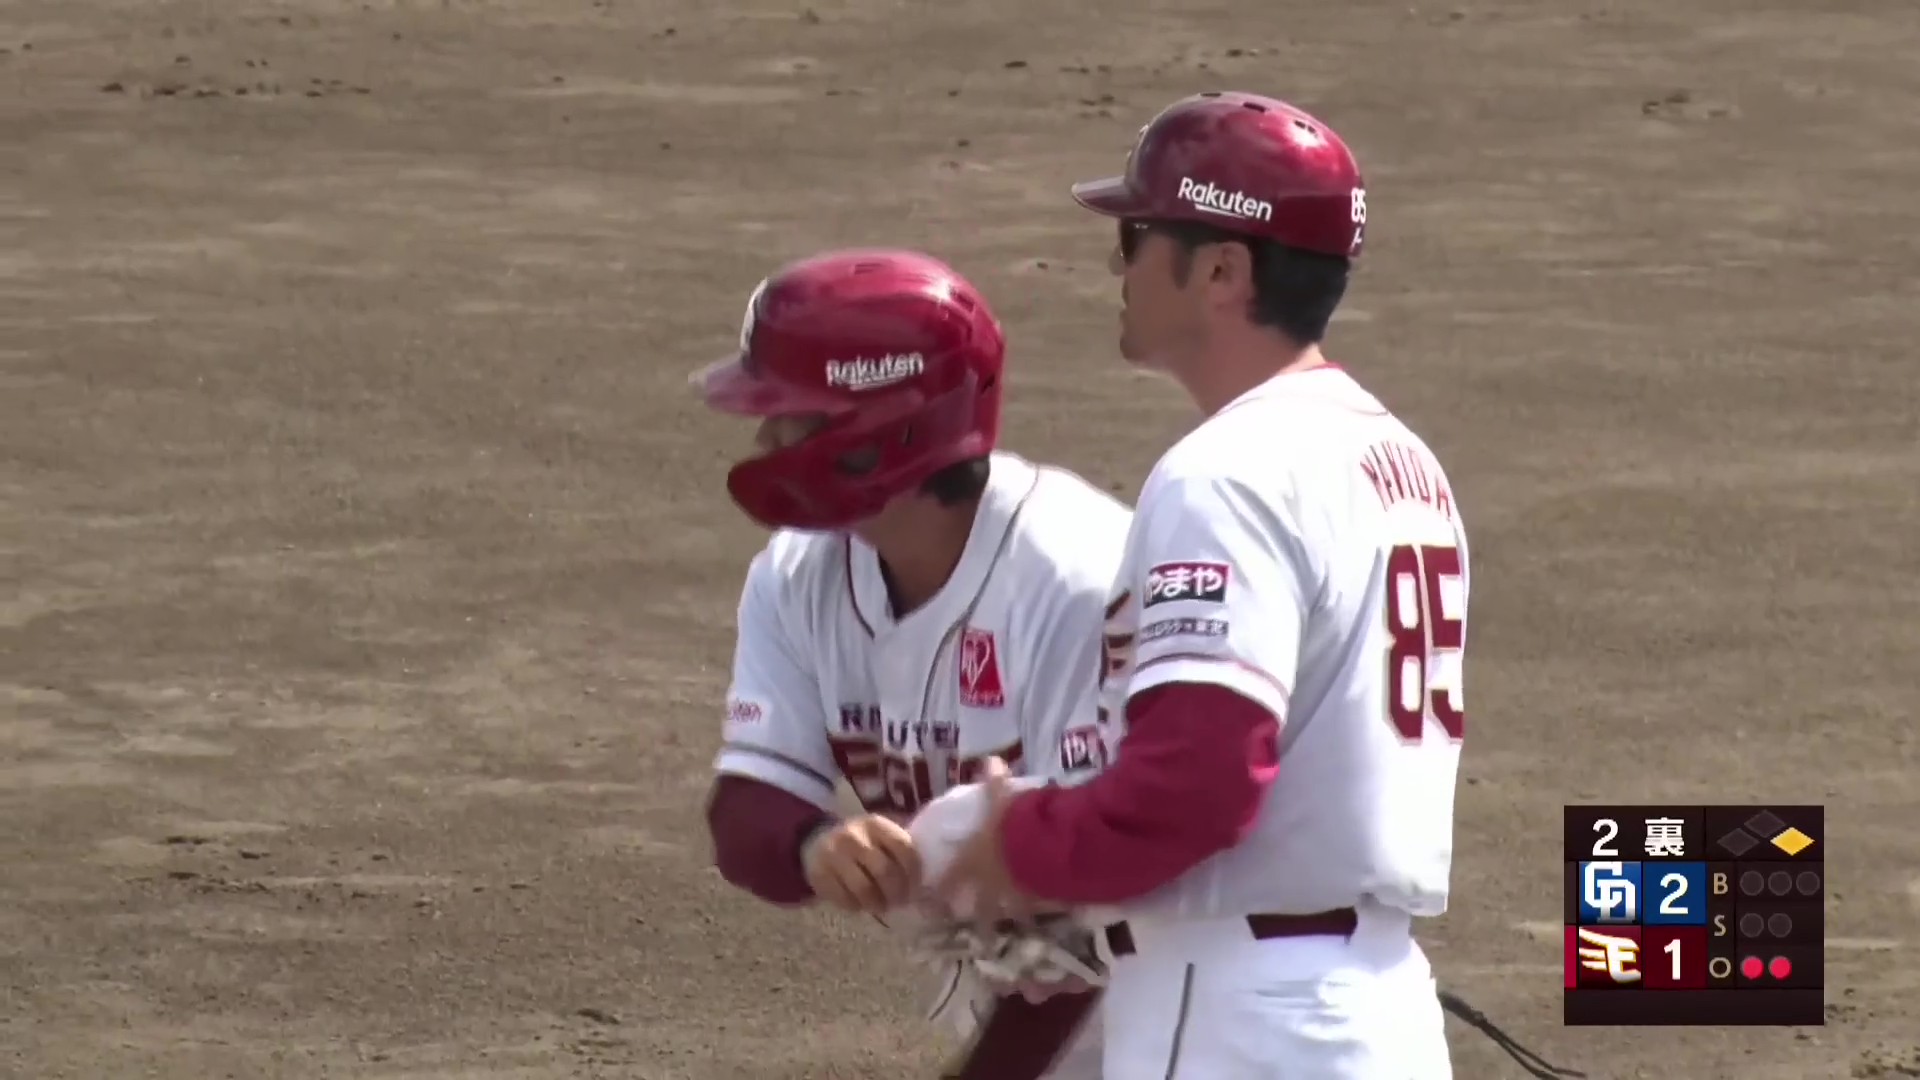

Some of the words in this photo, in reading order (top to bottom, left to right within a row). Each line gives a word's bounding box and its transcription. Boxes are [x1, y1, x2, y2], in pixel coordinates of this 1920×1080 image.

[1178, 177, 1272, 221] Rakuten
[1351, 187, 1367, 224] 85
[825, 352, 923, 391] Rakuten
[1145, 566, 1223, 598] やまや
[1382, 544, 1464, 744] 85
